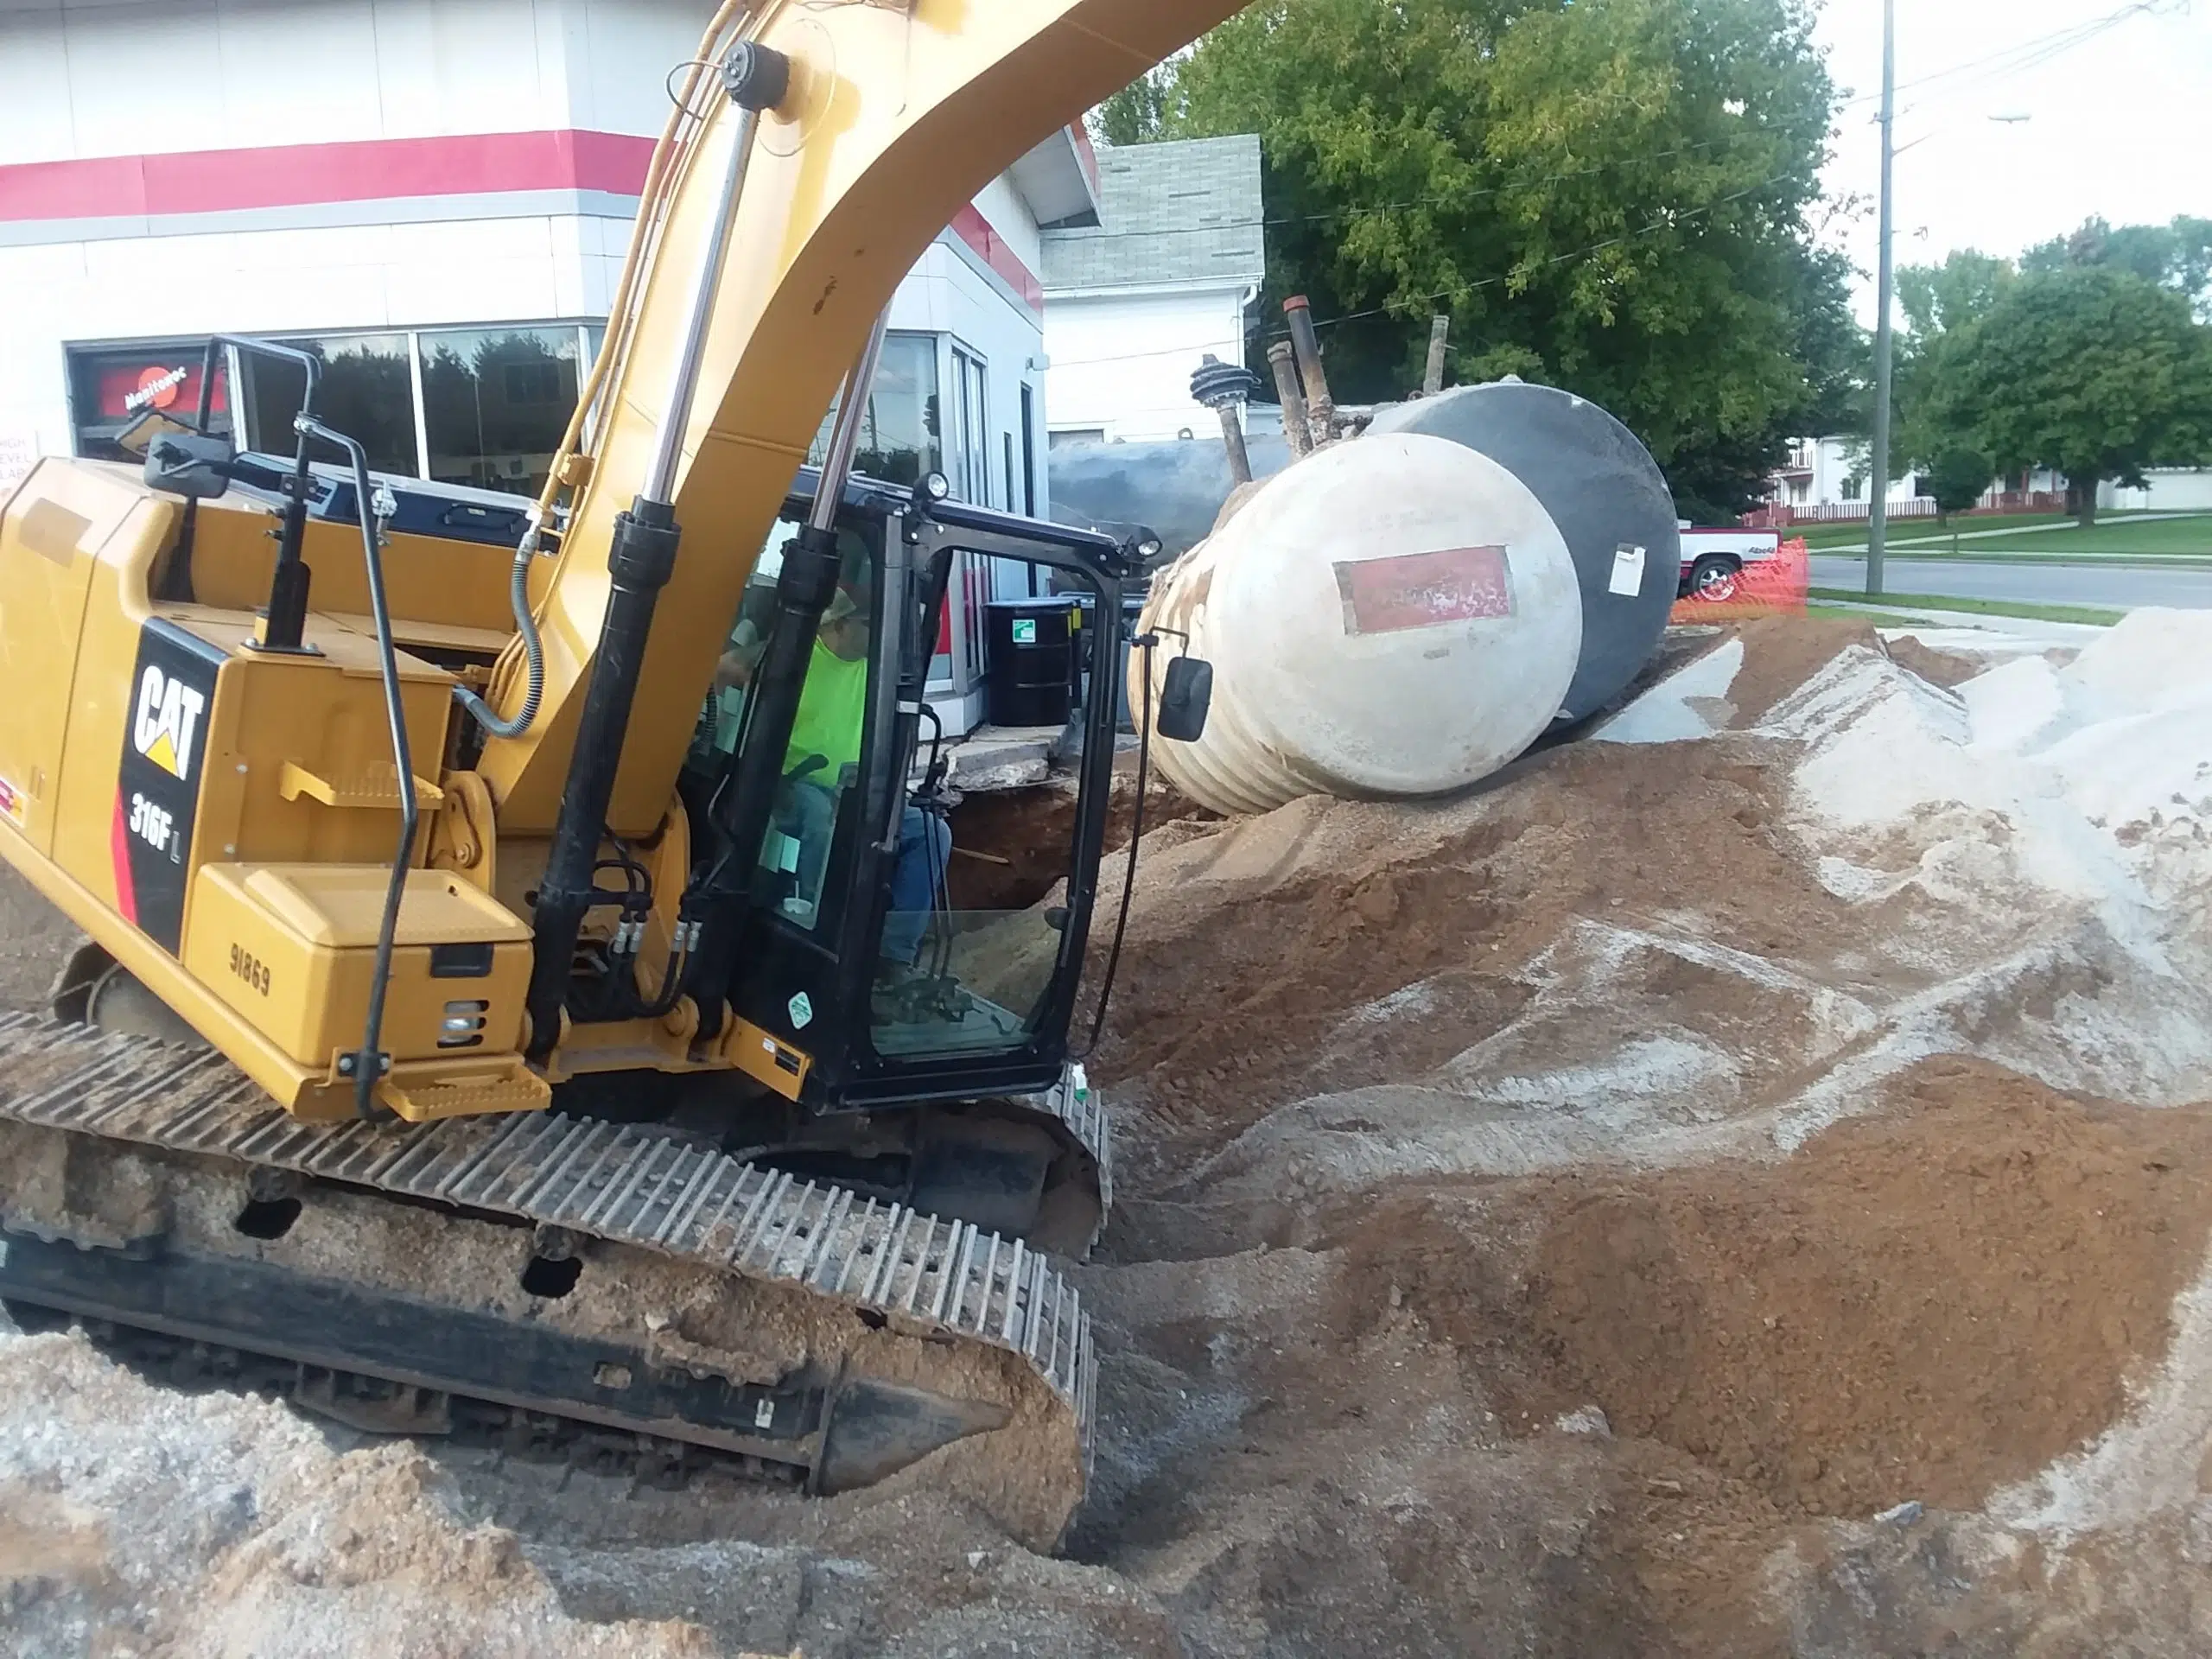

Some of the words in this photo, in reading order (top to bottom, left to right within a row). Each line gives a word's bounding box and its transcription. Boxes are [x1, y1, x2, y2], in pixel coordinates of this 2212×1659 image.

[124, 366, 187, 410] Manitowoc
[134, 665, 205, 781] CAT
[130, 792, 172, 851] 316F
[170, 830, 180, 864] L
[230, 942, 270, 997] 91869
